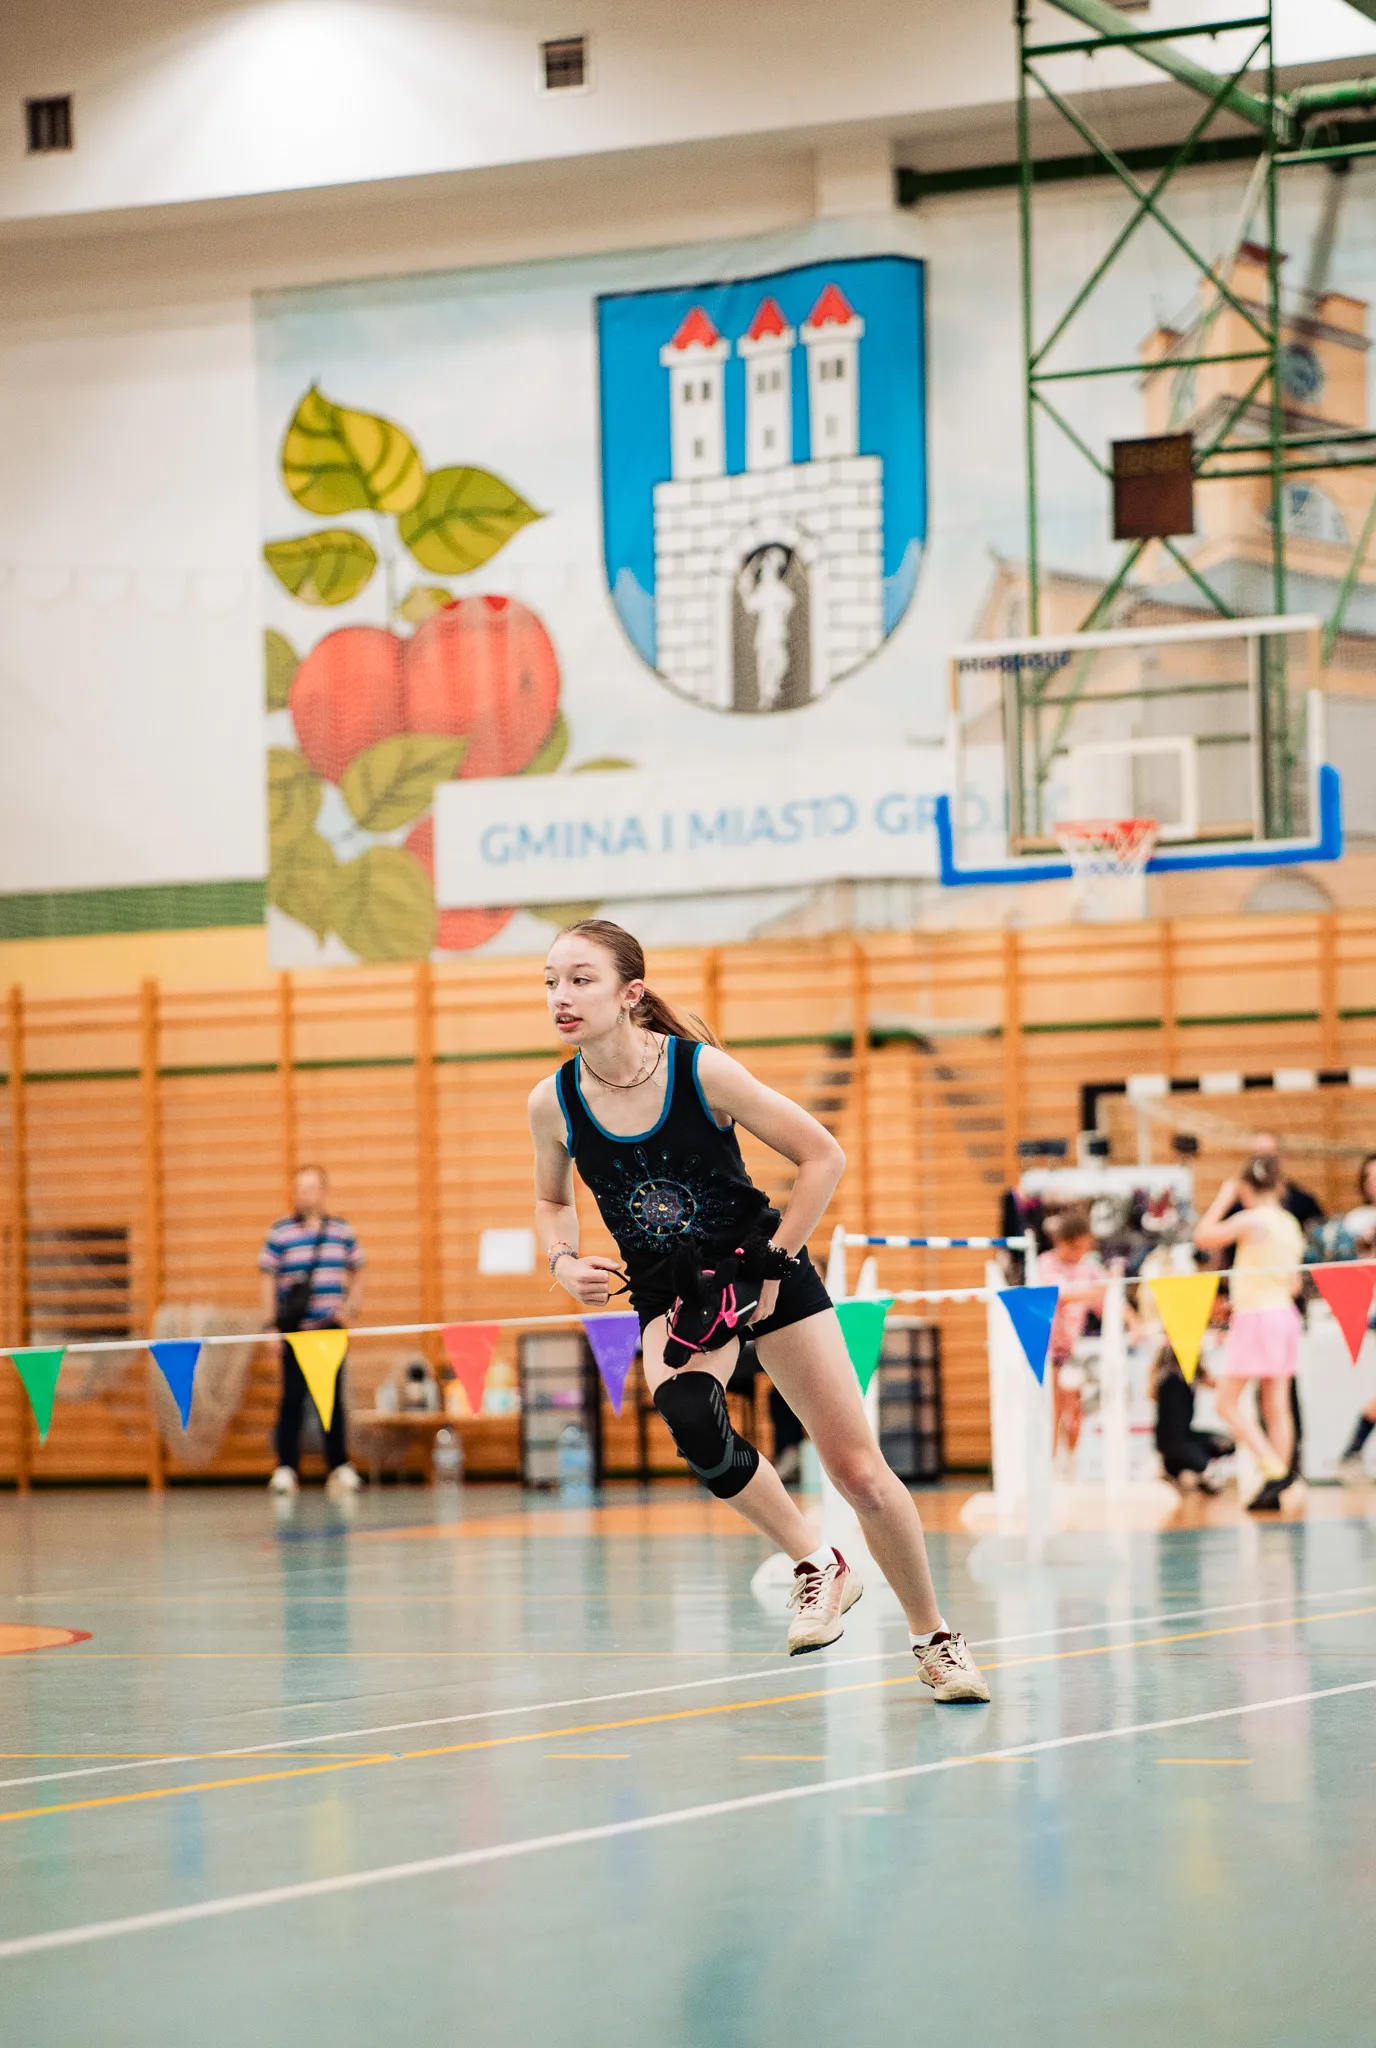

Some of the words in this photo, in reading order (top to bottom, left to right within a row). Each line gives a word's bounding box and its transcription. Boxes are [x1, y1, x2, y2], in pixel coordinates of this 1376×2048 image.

[478, 815, 649, 867] GMINA
[661, 810, 674, 854] I
[688, 794, 858, 849] MIASTO
